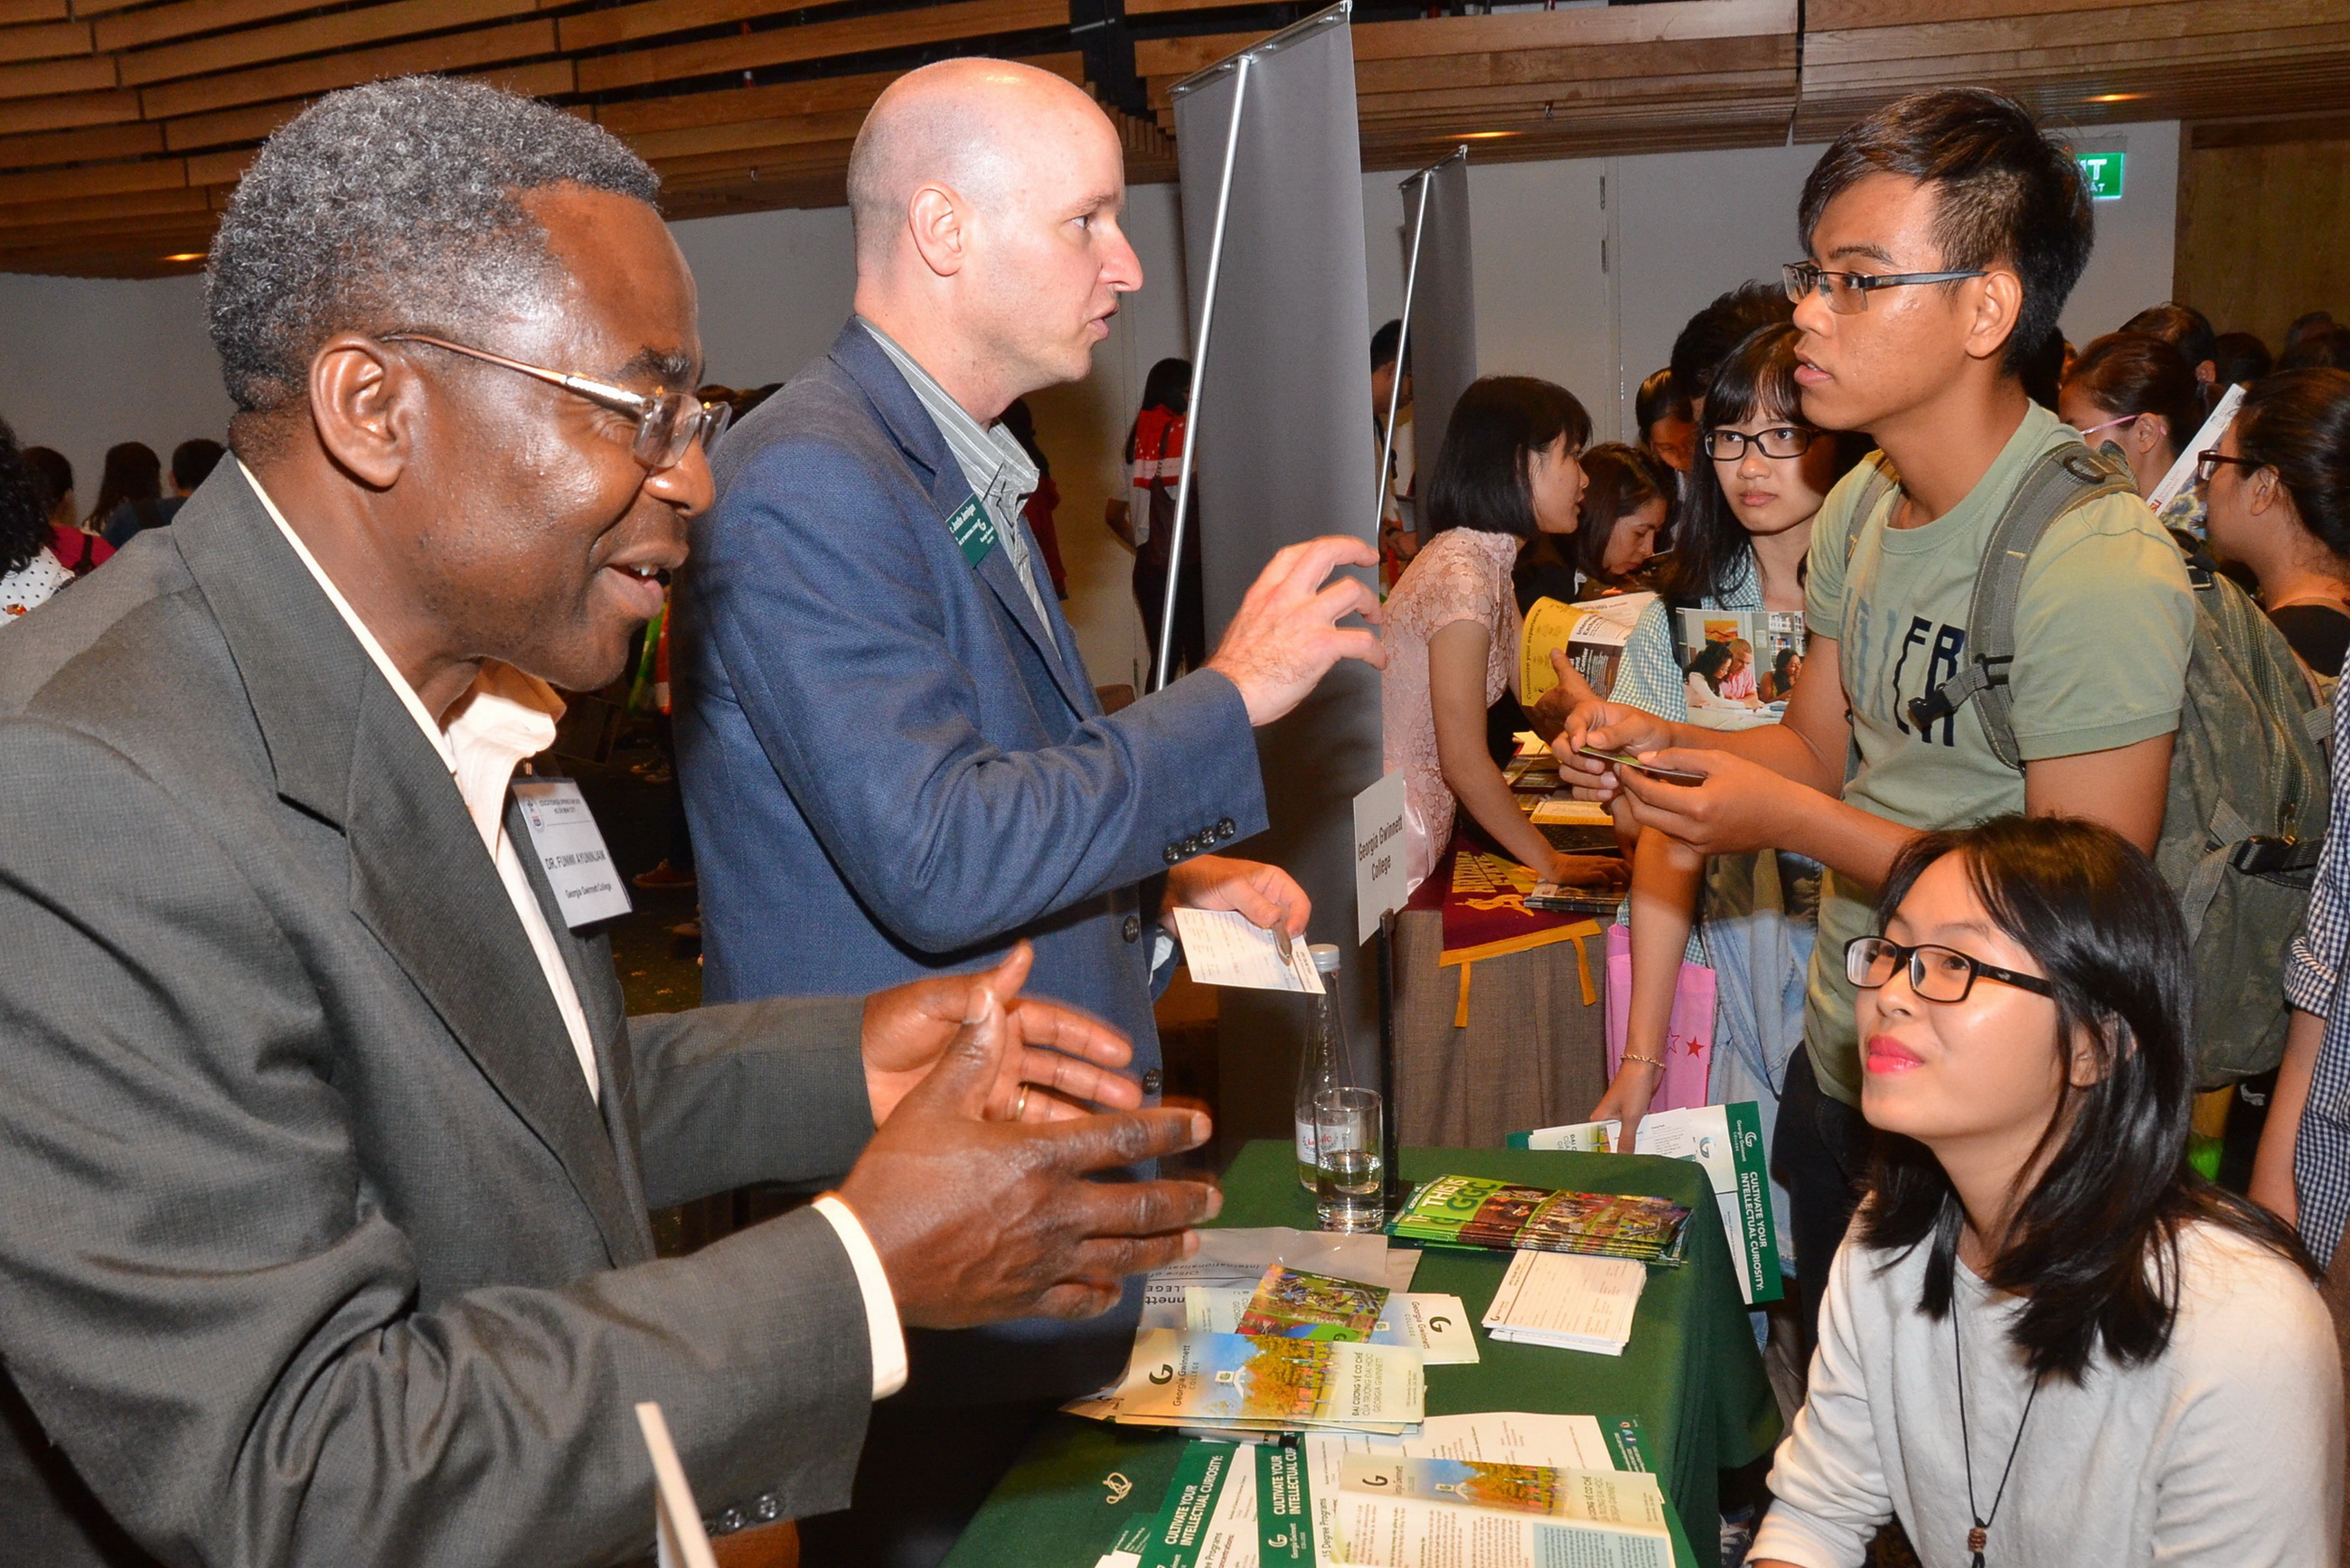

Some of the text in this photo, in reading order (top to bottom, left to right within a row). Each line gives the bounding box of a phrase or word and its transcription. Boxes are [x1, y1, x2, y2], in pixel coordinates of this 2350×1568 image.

[2150, 499, 2163, 513] SU
[1358, 814, 1403, 861] Georgia Gwinnett
[545, 858, 558, 870] DR.
[1371, 855, 1391, 881] College
[565, 887, 582, 899] Georgia
[598, 882, 612, 893] College
[1422, 1185, 1460, 1207] THIS
[1447, 1181, 1497, 1211] GGC
[1750, 1171, 1767, 1247] CULTIVATE YOUR
[1741, 1172, 1764, 1291] INTELLECTUAL CURIOSITY:
[1145, 1296, 1185, 1305] nnett
[1412, 1301, 1430, 1349] Georgia Gwinnett
[1173, 1345, 1190, 1406] Georgia Gwinnett
[1189, 1362, 1199, 1390] COLLEGE
[1373, 1357, 1383, 1413] GEORGIA GWINNETT
[1180, 1455, 1224, 1546] INTELLECTUAL CURIOSITY:
[1271, 1455, 1285, 1515] CULTIVATE YOUR
[1285, 1463, 1301, 1515] INTELLECTUAL
[1165, 1485, 1198, 1545] CULTIVATE YOUR
[1320, 1498, 1330, 1525] Programs
[1205, 1532, 1223, 1562] Programs
[1218, 1535, 1235, 1568] oncentrations:
[1321, 1526, 1333, 1549] Degree
